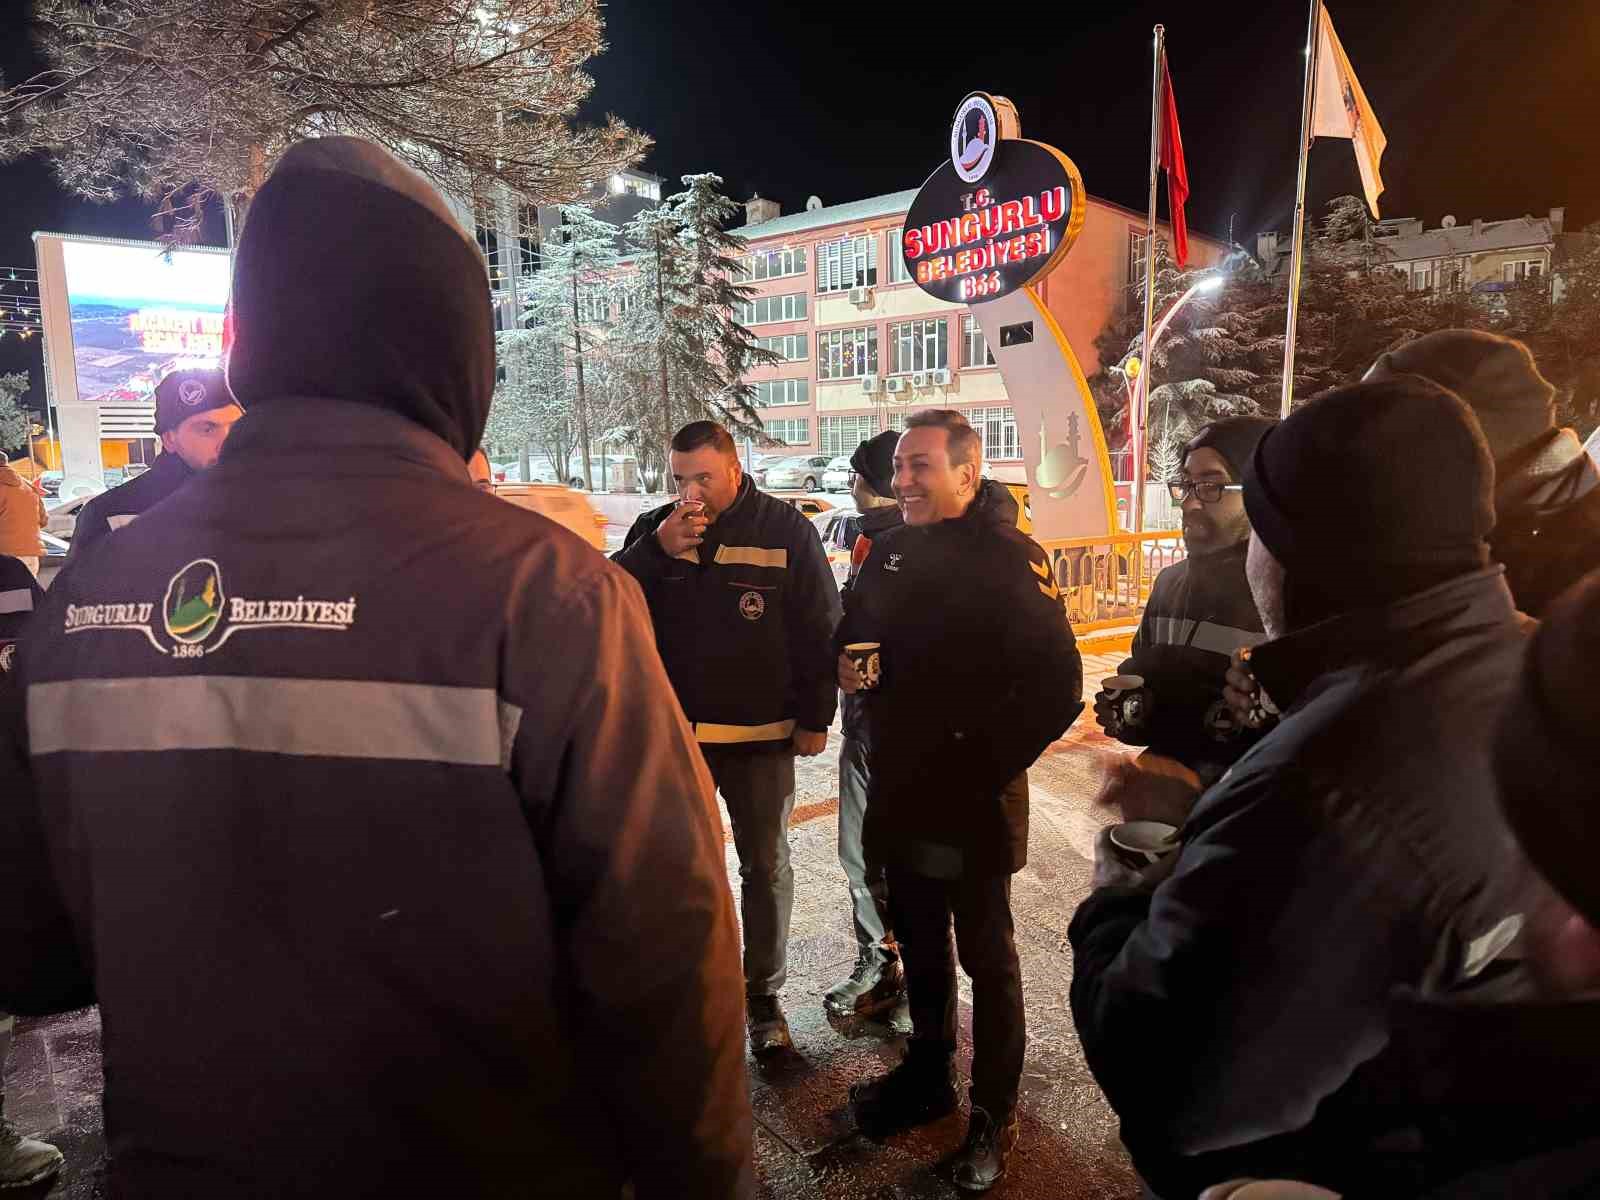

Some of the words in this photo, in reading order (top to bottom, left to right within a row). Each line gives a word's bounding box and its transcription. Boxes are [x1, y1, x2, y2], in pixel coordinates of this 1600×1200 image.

[960, 189, 995, 211] T.C.
[904, 187, 1065, 259] SUNGURLU
[917, 223, 1050, 283] BELEDİYESİ
[65, 603, 154, 627] SUNGURLU
[229, 595, 357, 624] BELEDİYESİ
[171, 645, 205, 658] 1866
